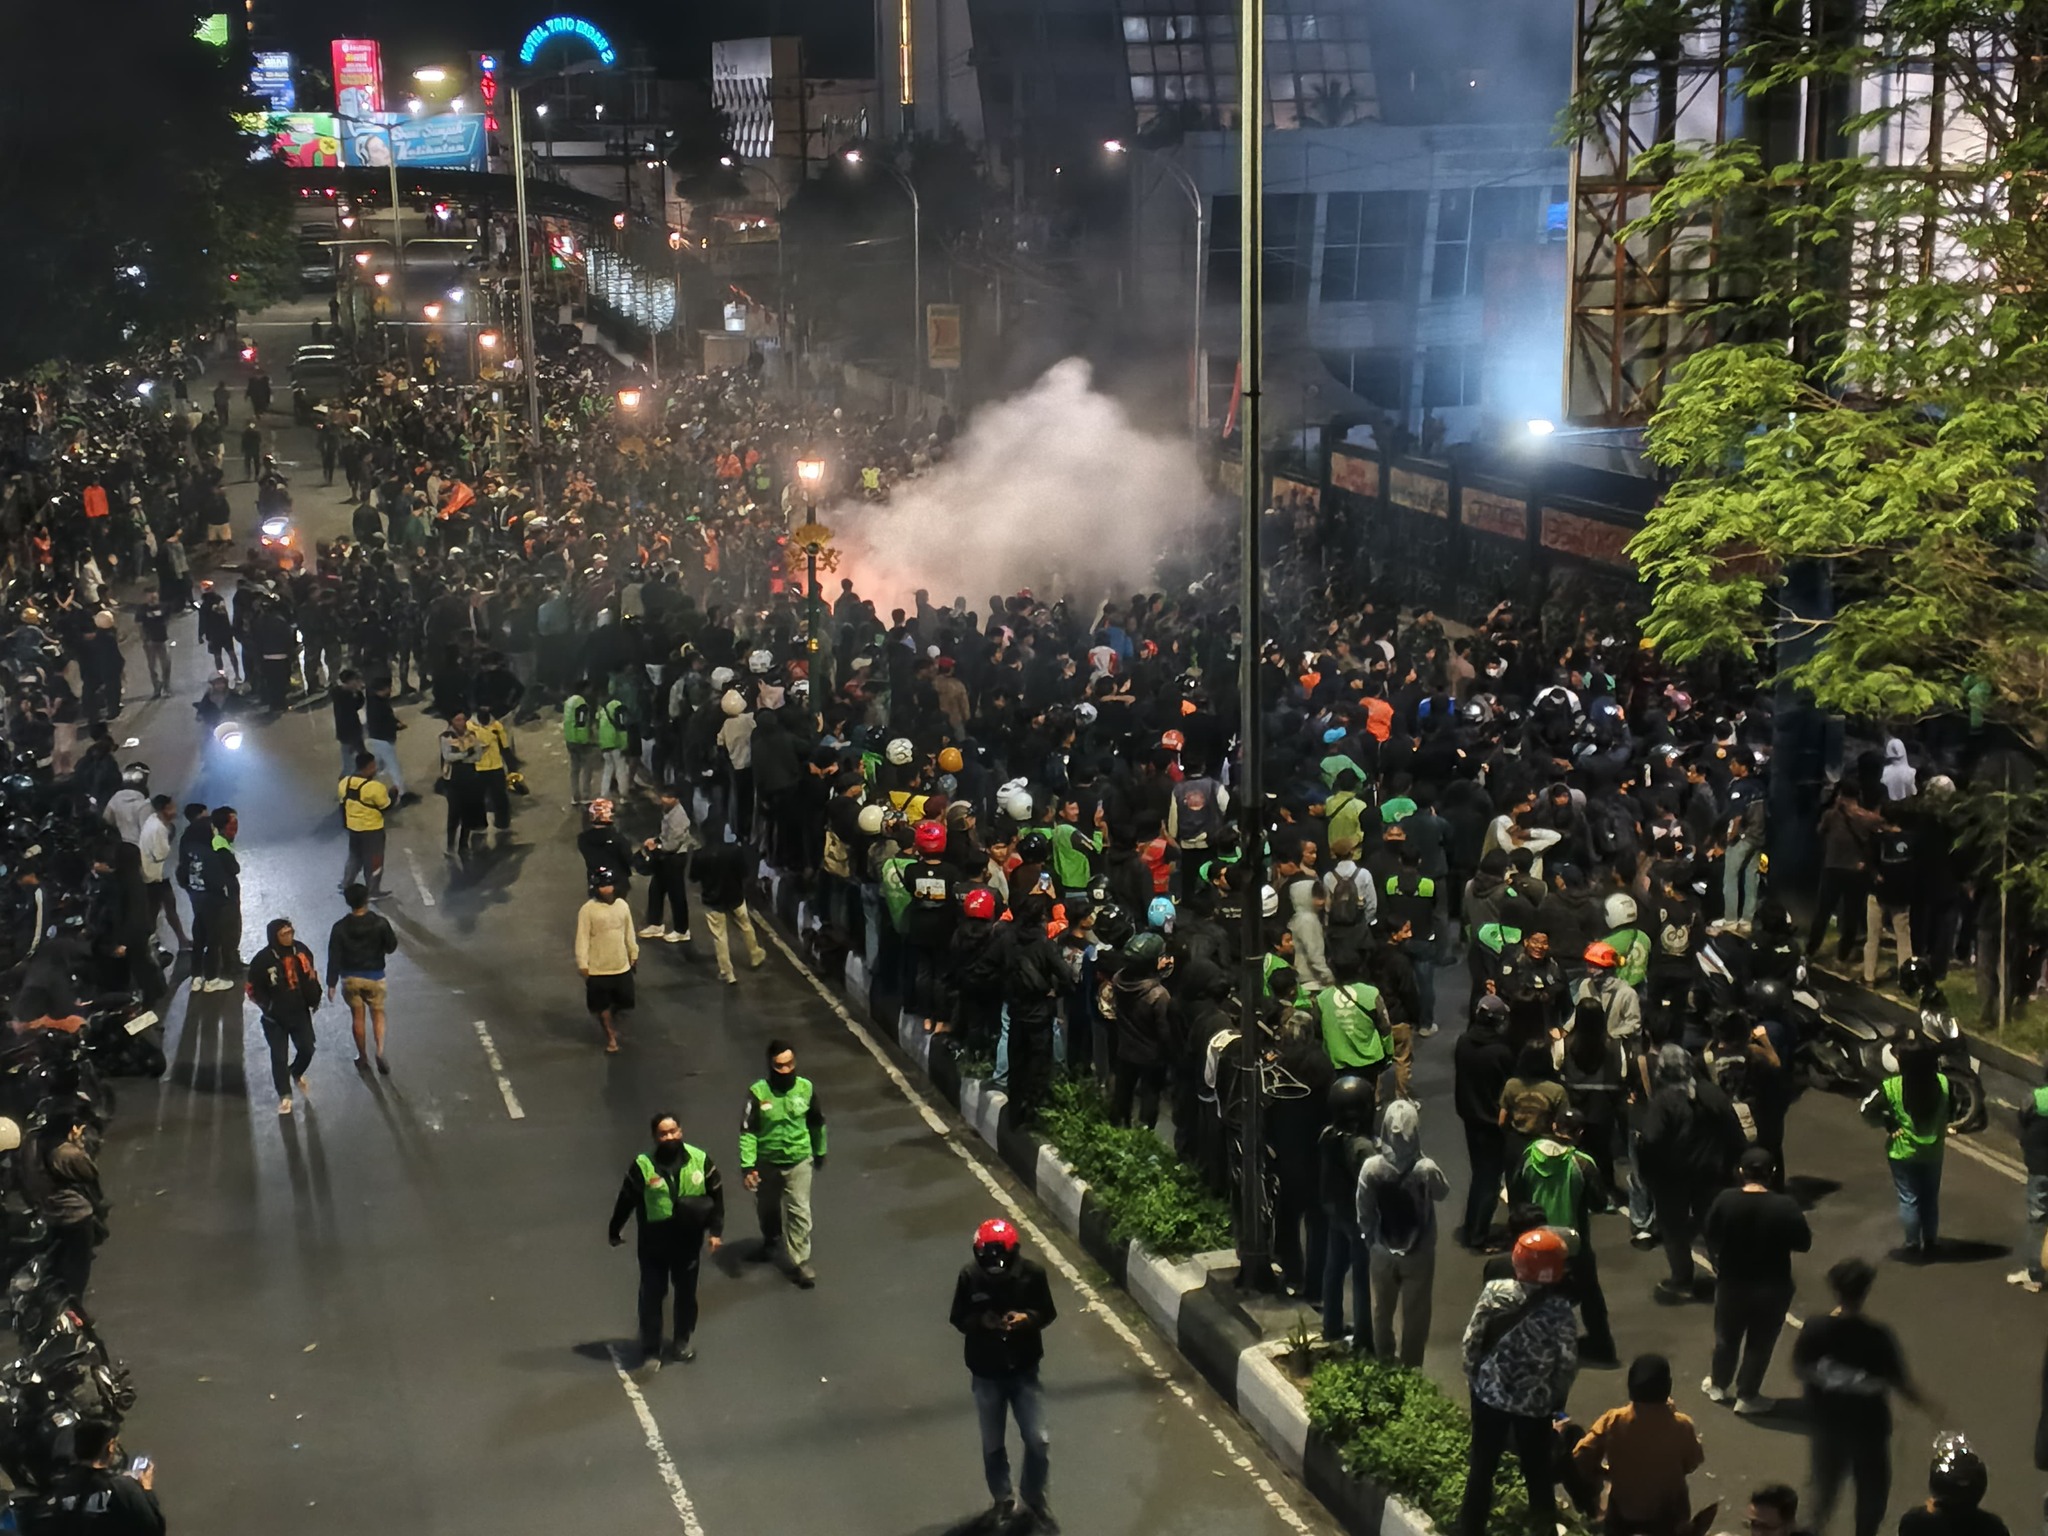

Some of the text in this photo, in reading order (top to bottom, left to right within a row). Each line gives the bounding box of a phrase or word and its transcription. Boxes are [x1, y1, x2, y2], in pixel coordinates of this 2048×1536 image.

[520, 25, 549, 62] HOTEL
[545, 17, 575, 33] TRIO
[601, 48, 614, 64] 2
